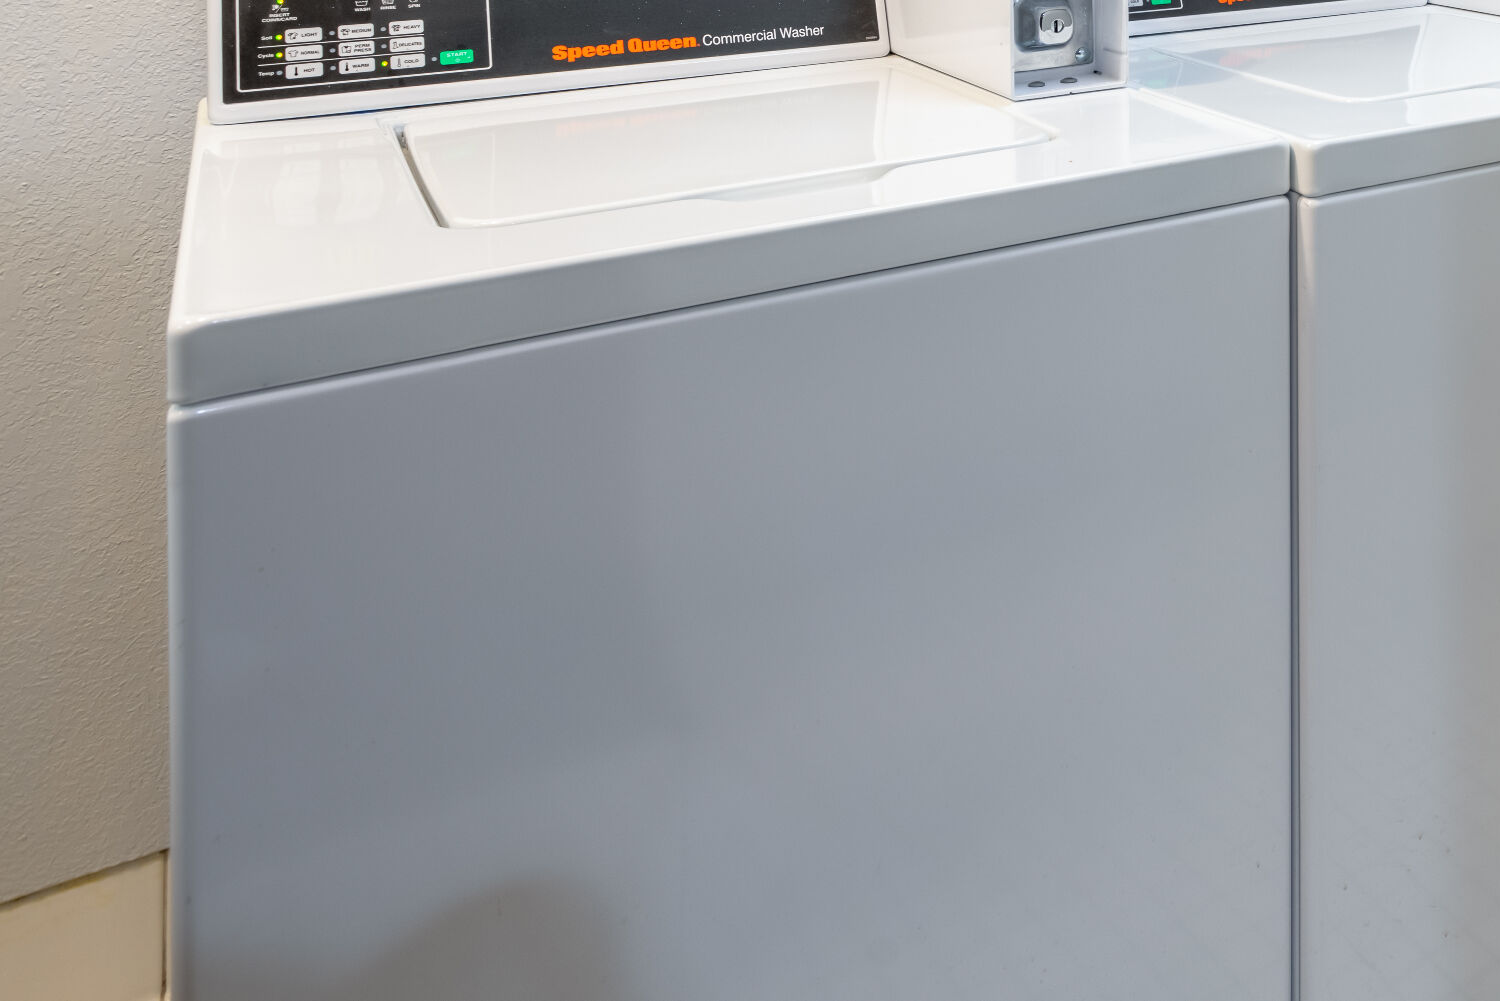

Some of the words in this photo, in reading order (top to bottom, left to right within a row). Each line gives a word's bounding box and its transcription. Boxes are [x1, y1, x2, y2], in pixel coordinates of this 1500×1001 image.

[551, 39, 625, 62] Speed
[627, 34, 697, 53] Queen
[702, 29, 777, 47] Commercial
[779, 25, 825, 40] Washer
